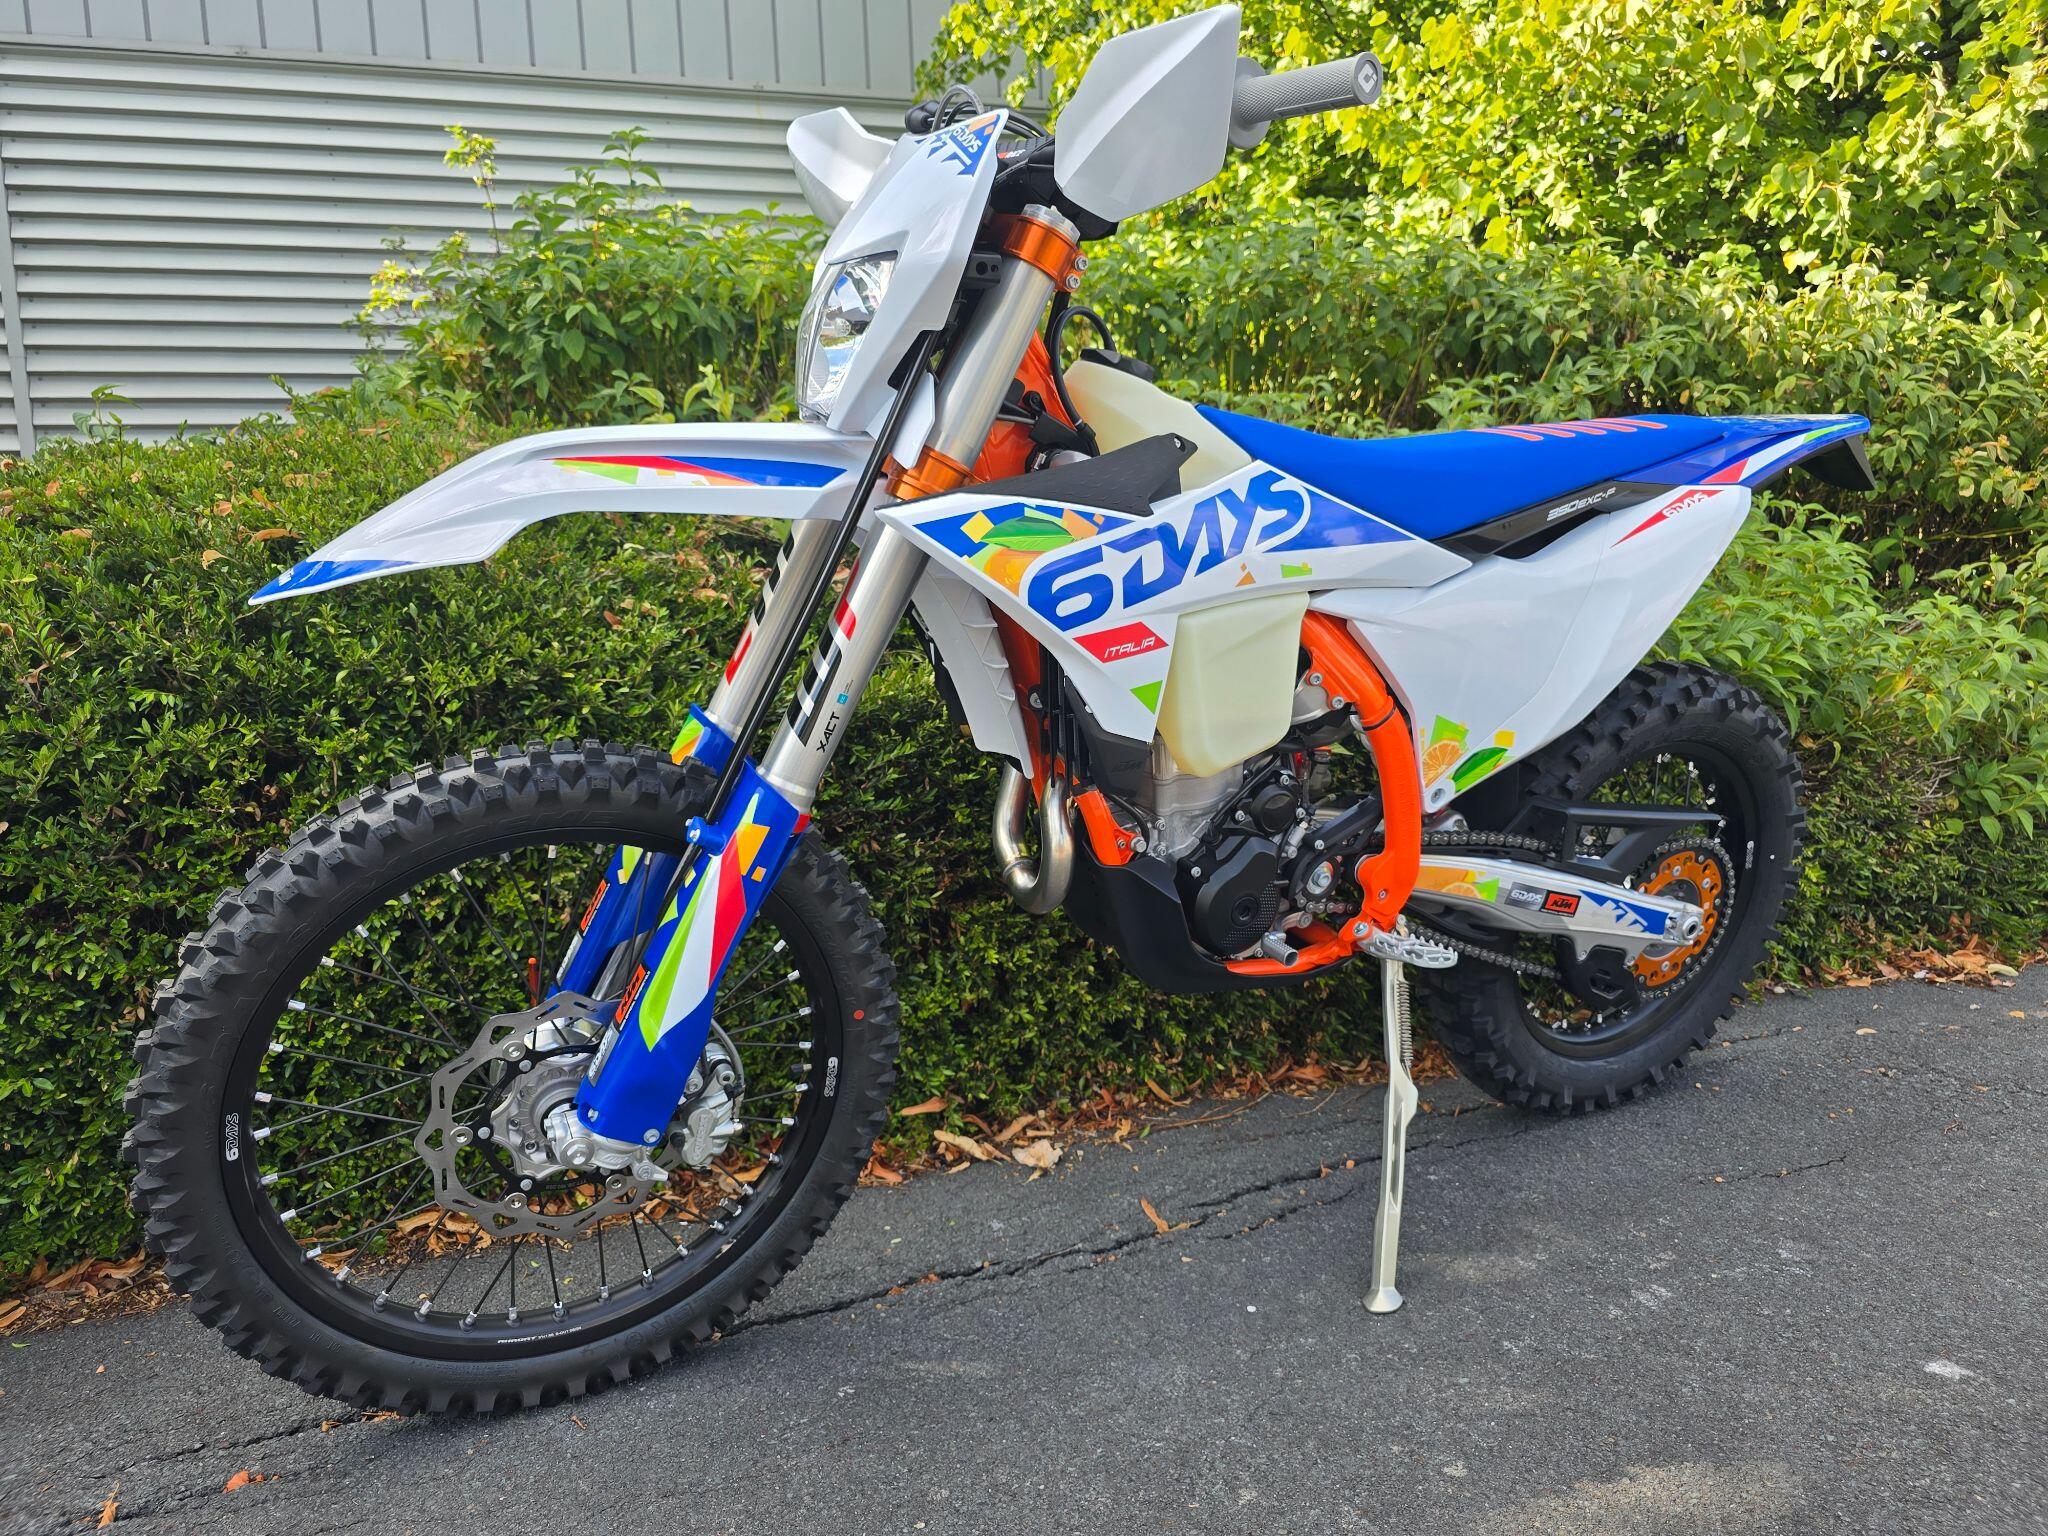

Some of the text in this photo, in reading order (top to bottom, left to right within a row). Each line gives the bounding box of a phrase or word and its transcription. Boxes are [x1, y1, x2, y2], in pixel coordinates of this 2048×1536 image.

[1027, 469, 1305, 632] 6DAYS
[1103, 636, 1157, 659] ITALIA
[815, 710, 840, 753] XACT
[1550, 897, 1574, 910] KTM
[225, 1112, 239, 1162] 6DAYS
